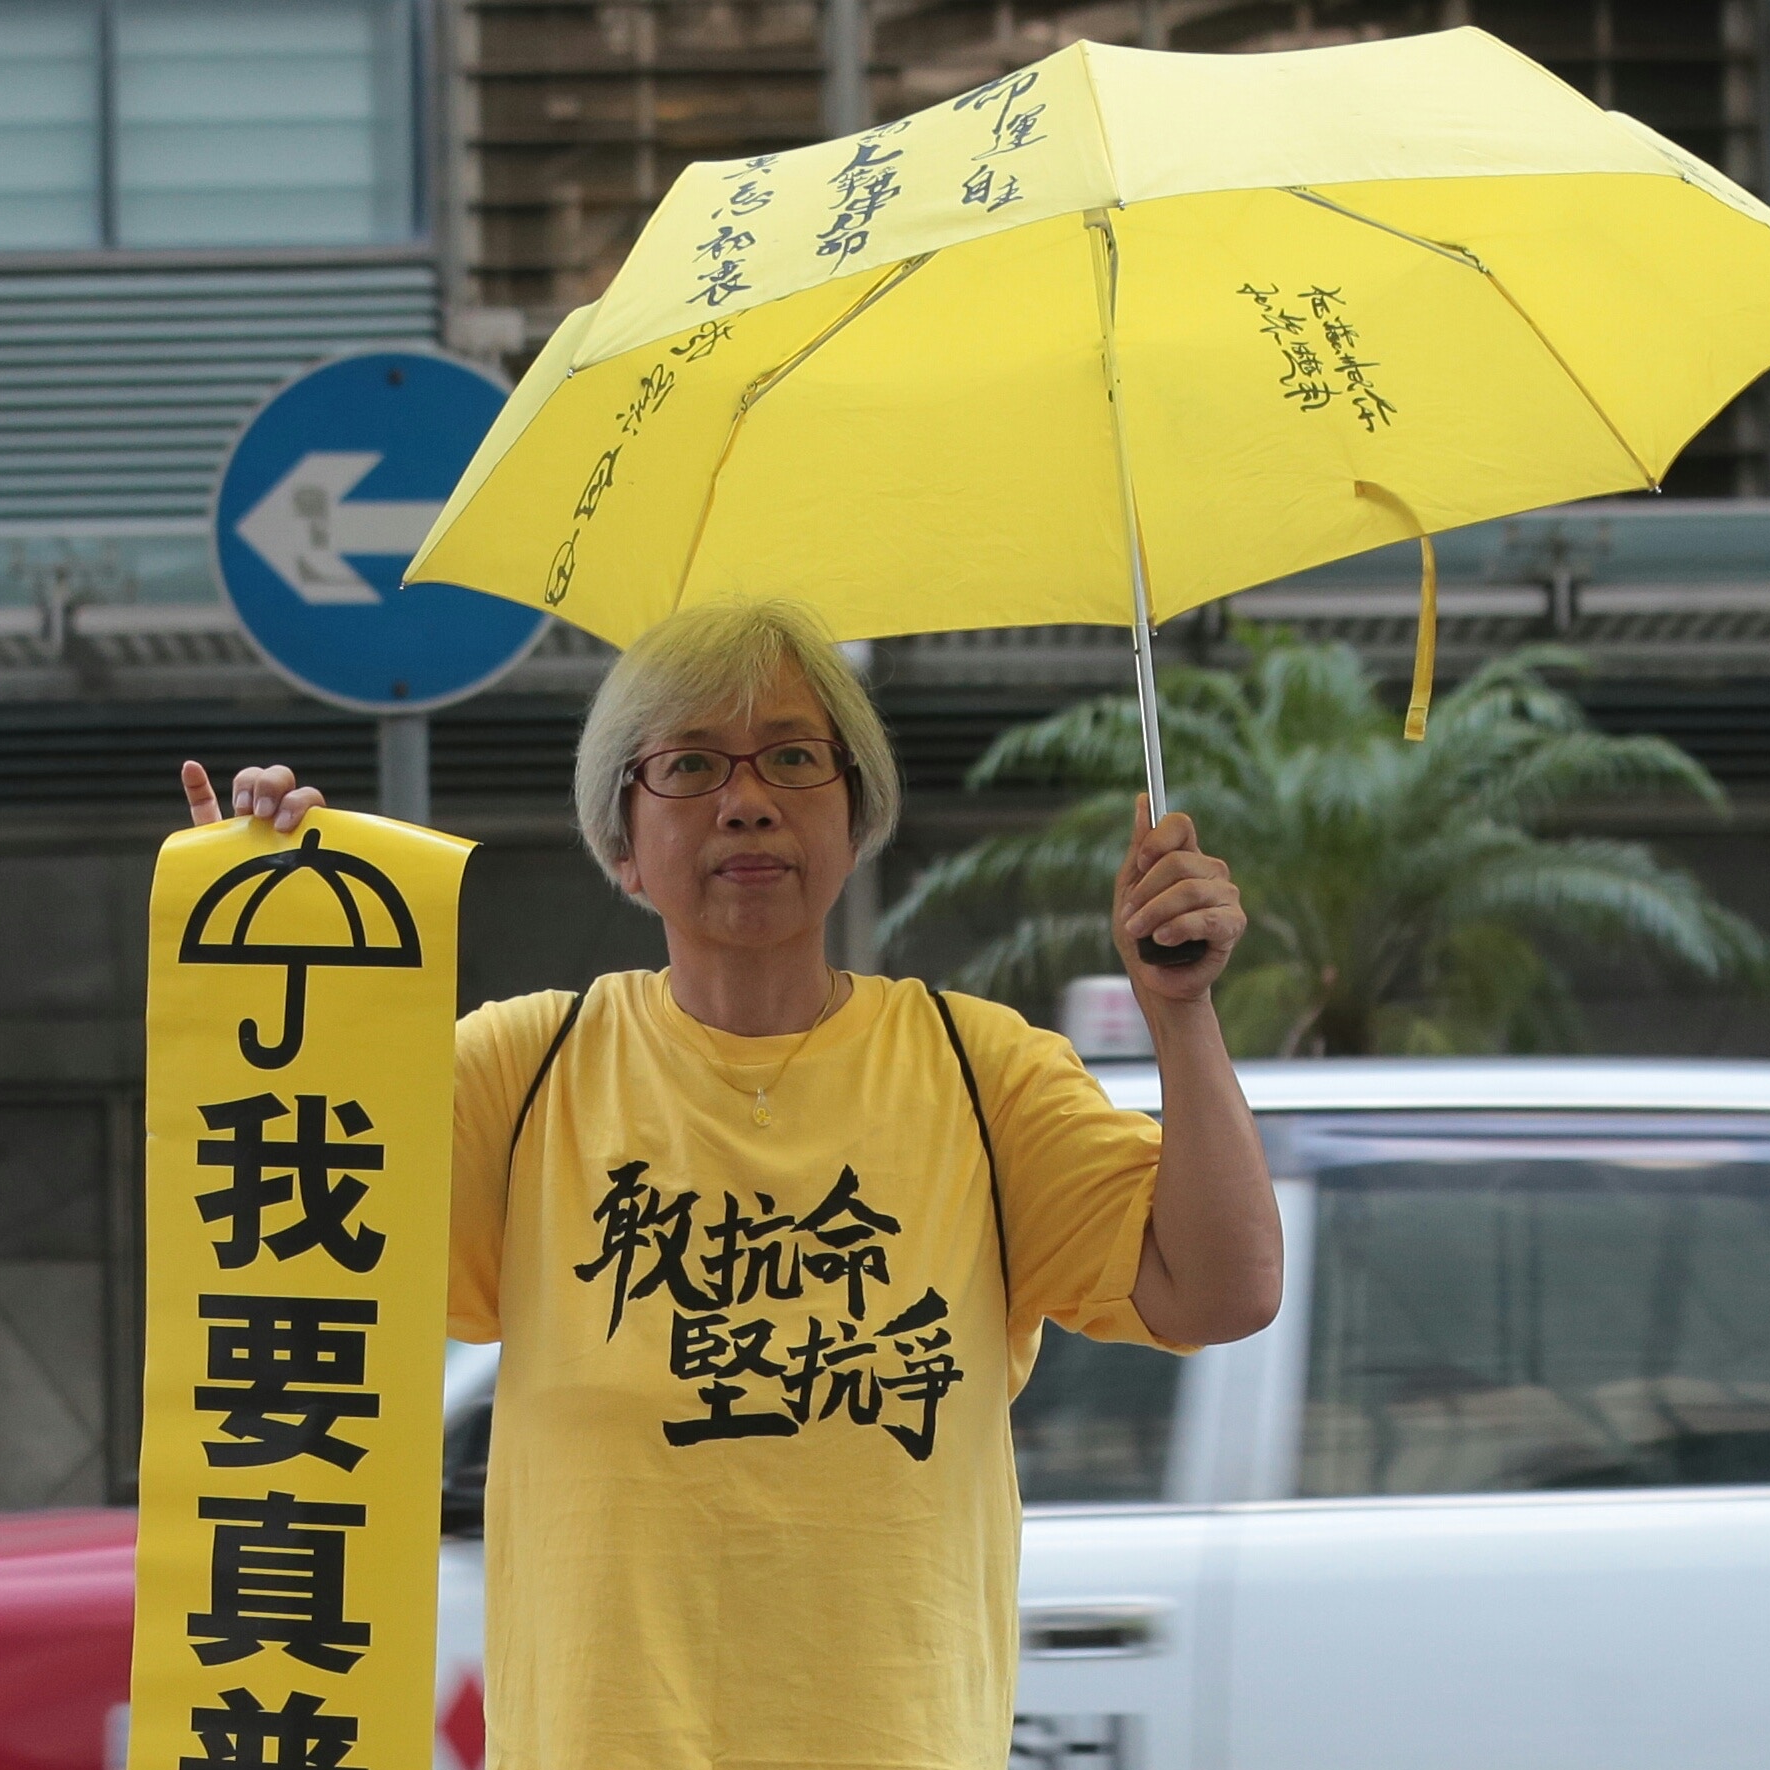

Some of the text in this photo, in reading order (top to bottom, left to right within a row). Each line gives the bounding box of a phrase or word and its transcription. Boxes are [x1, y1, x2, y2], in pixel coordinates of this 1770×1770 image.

[574, 1160, 901, 1343] 敢抗命
[663, 1287, 964, 1461] 堅抗爭
